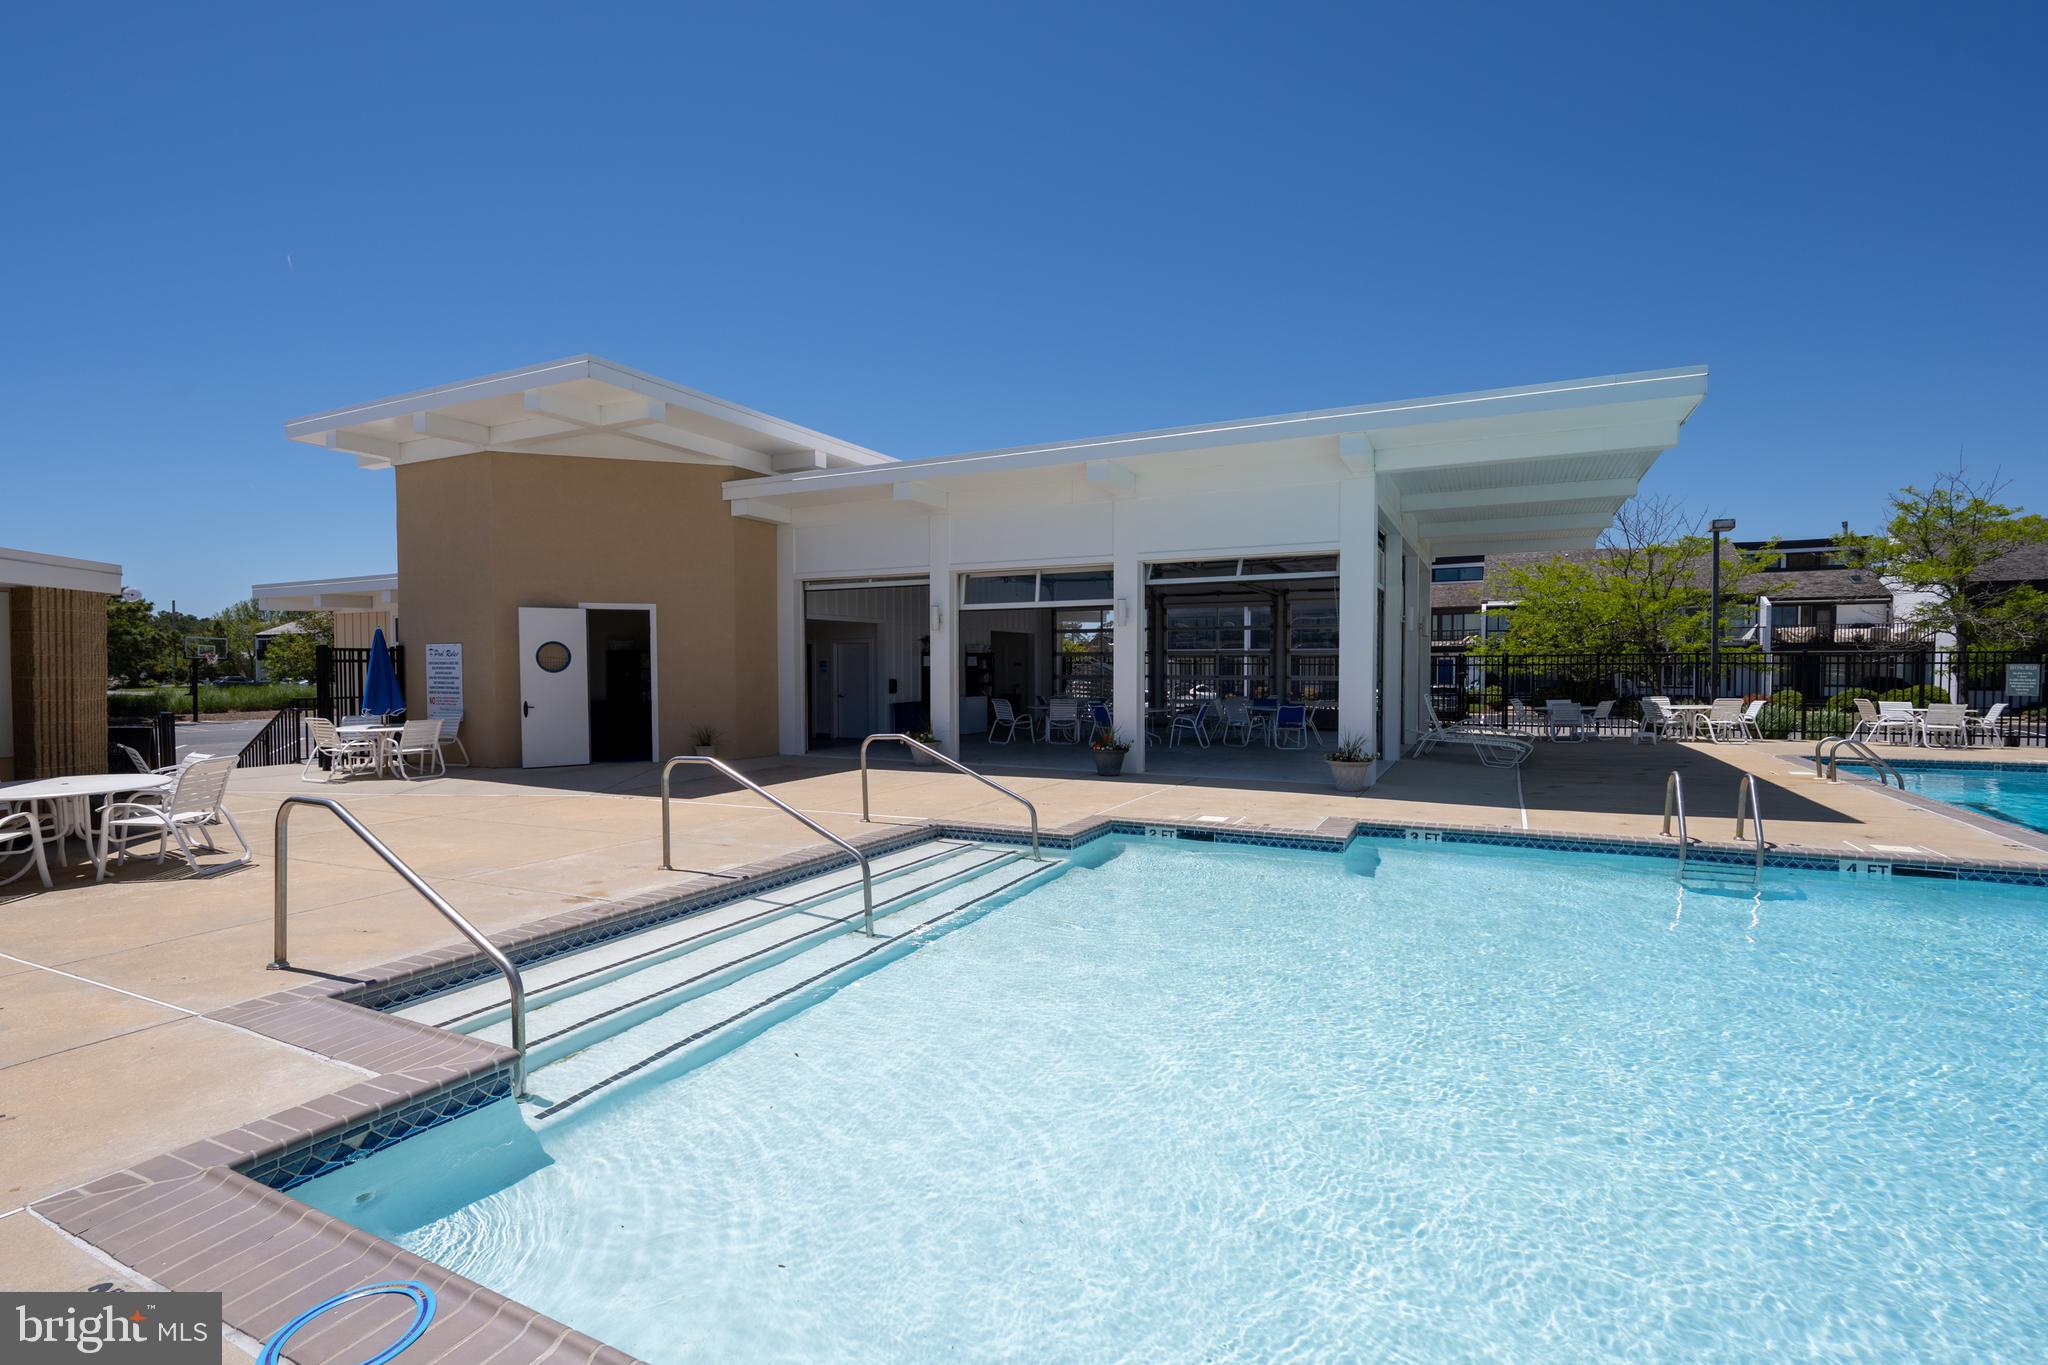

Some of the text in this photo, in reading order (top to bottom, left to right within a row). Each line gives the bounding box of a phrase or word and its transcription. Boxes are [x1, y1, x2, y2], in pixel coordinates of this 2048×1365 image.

[1149, 829, 1175, 839] 2 FT
[1410, 831, 1441, 841] 3 FT
[1846, 863, 1889, 875] 4 FT
